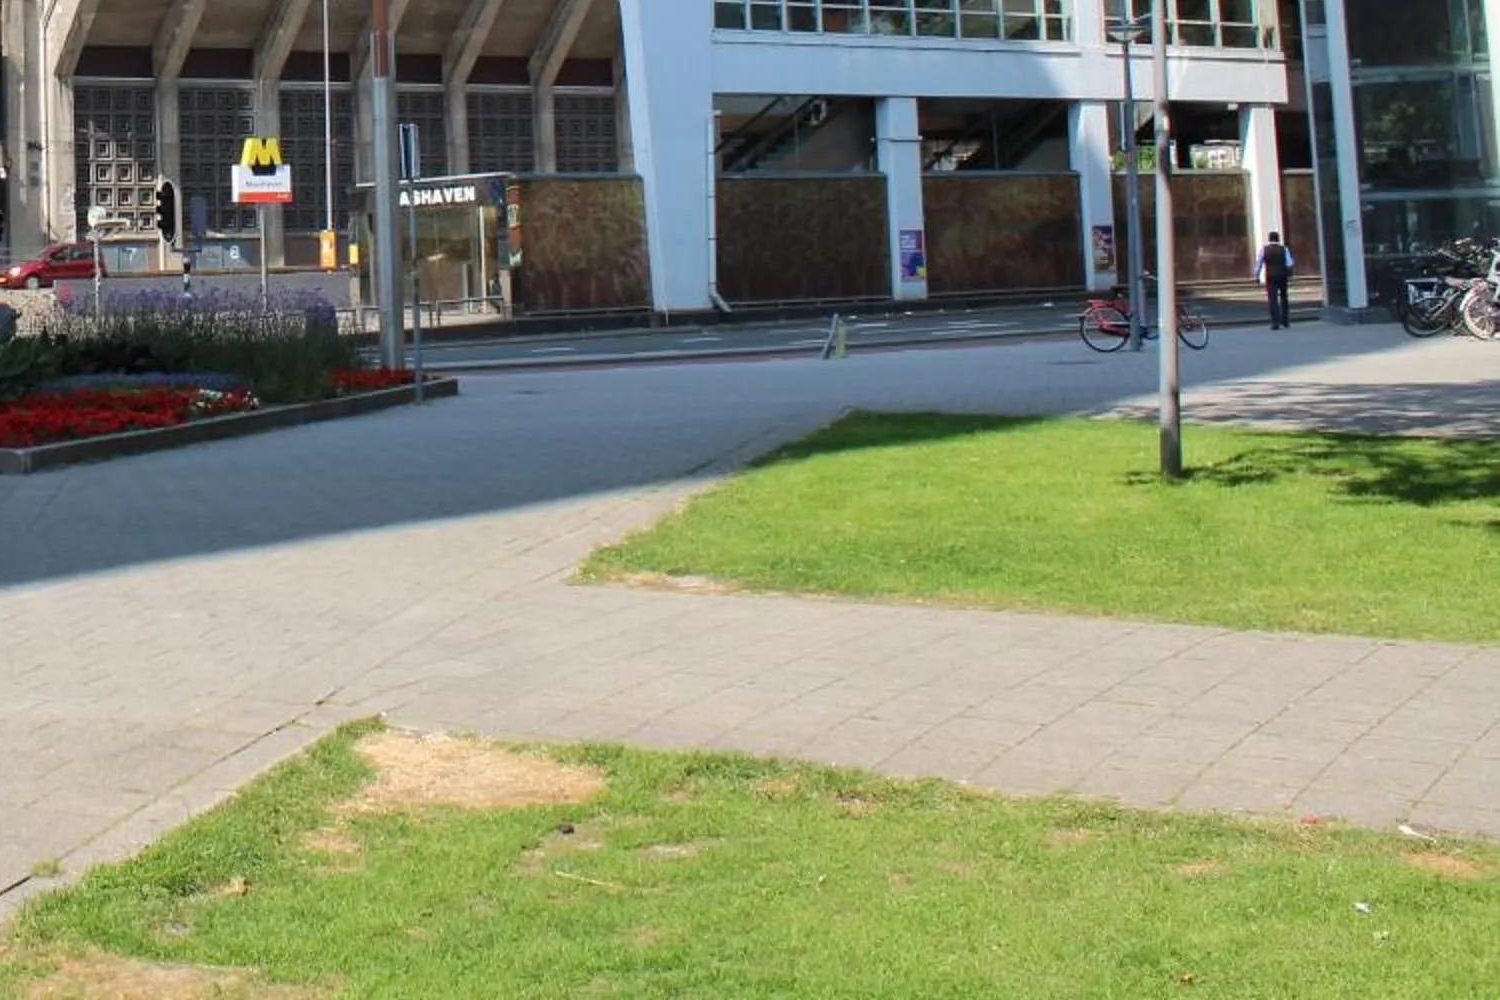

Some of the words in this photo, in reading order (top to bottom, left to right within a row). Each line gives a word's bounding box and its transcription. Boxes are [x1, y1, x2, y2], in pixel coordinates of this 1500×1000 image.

[241, 138, 282, 167] M
[399, 185, 476, 207] ASHAVEN
[125, 247, 137, 263] 7
